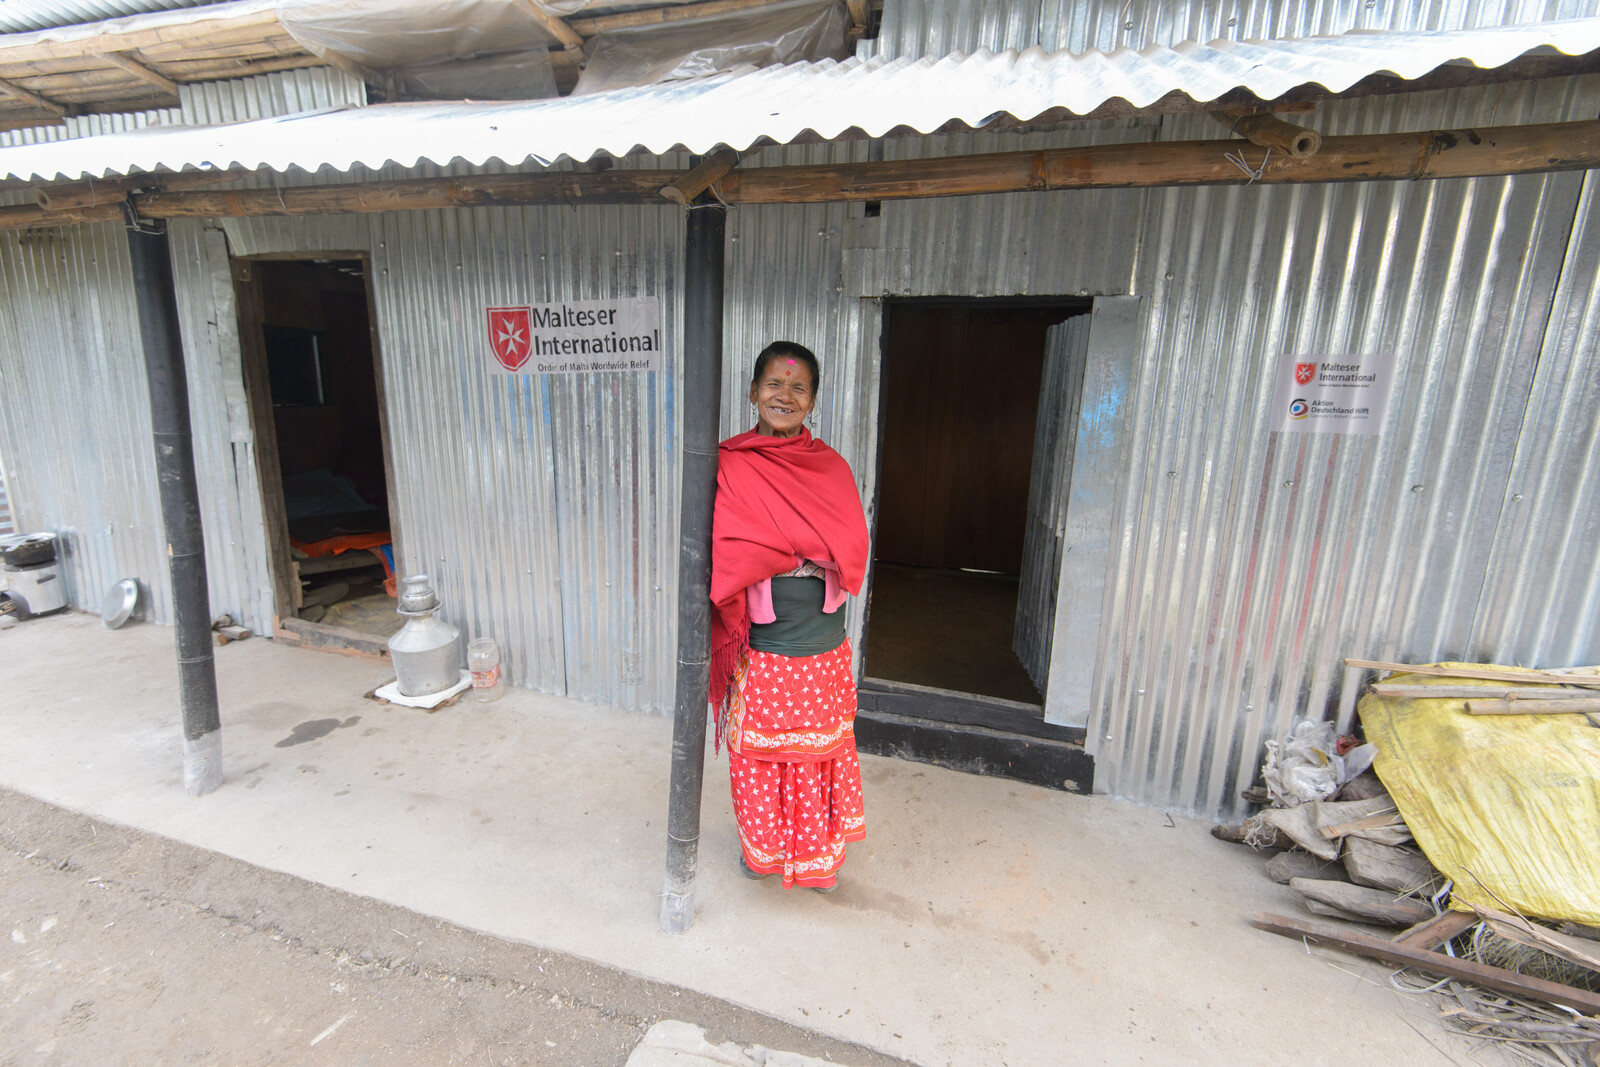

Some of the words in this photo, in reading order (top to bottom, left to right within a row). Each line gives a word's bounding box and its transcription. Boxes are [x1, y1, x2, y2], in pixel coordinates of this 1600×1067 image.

[532, 305, 617, 328] Malteser
[535, 329, 659, 356] International
[537, 363, 557, 372] Order
[559, 362, 568, 371] of
[569, 362, 589, 371] Malta
[590, 361, 629, 371] Worldwide
[630, 359, 650, 369] Relief
[1321, 363, 1360, 371] Malteser
[1319, 373, 1376, 382] International
[1355, 407, 1370, 415] Hilft
